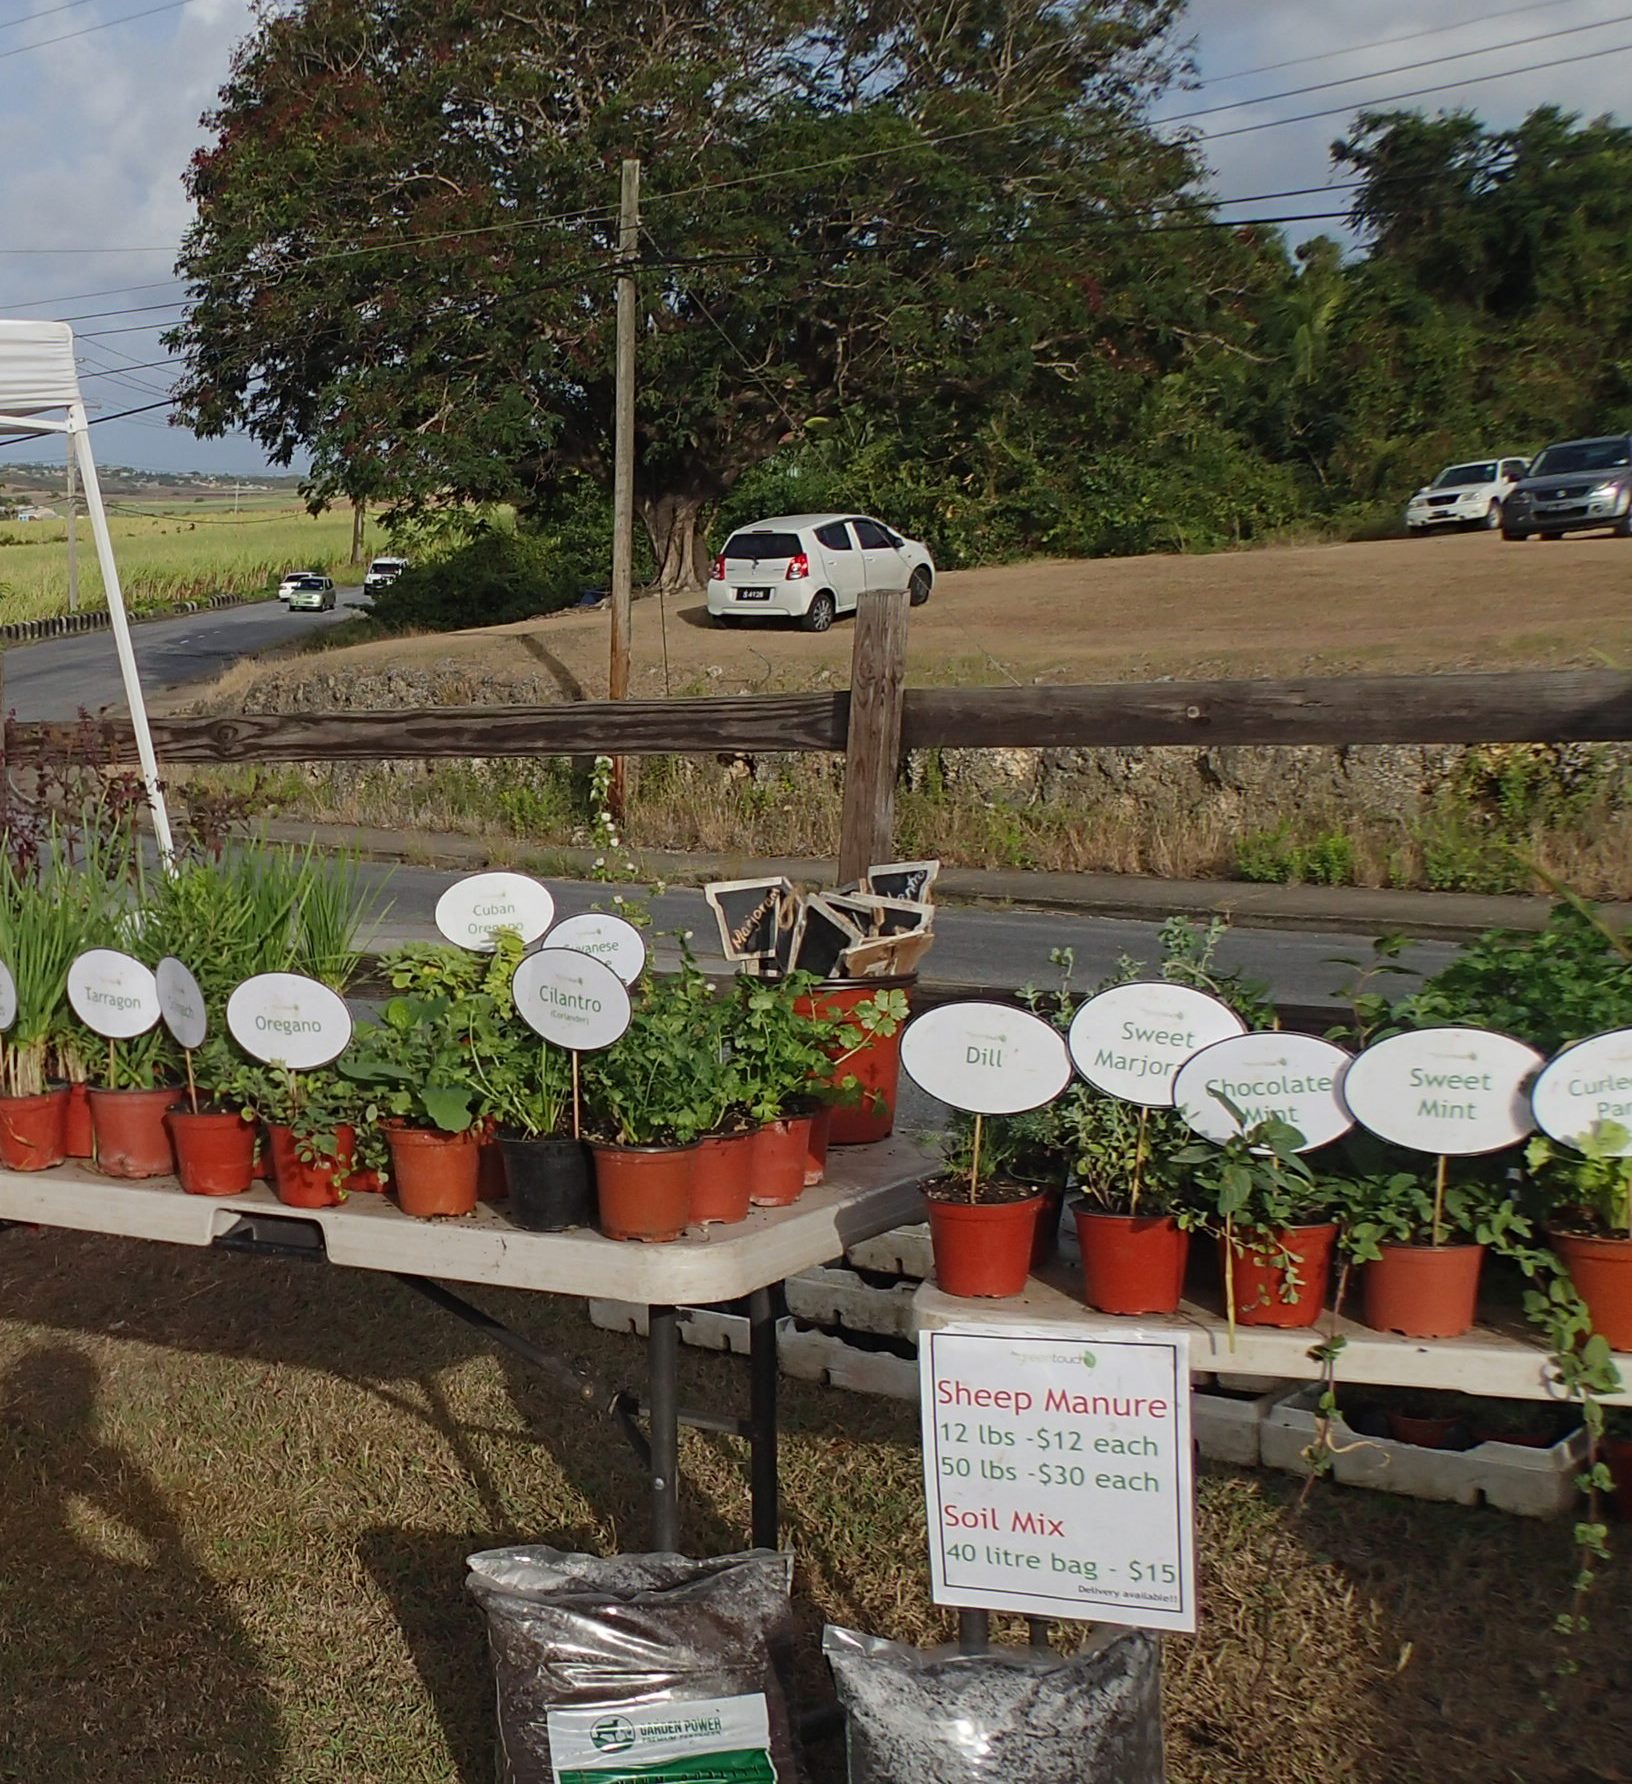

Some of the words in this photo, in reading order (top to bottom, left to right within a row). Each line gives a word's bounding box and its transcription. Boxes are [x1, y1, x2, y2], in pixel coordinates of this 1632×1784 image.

[473, 904, 515, 916] Cuban
[85, 986, 141, 1010] Tarragon
[539, 985, 601, 1012] Cilantro
[255, 1015, 322, 1036] Oregano
[1121, 1021, 1195, 1048] Sweet
[966, 1046, 1003, 1067] Dill
[1094, 1049, 1183, 1077] Marjor
[1205, 1075, 1332, 1097] Chocolate
[1409, 1068, 1492, 1091] Sweet
[1569, 1075, 1632, 1097] Curle
[1417, 1099, 1477, 1120] Mint
[937, 1380, 1033, 1415] Sheep
[1044, 1388, 1168, 1418] Manure
[940, 1423, 968, 1443] 12
[979, 1424, 1015, 1446] lbs
[1026, 1427, 1083, 1451] -$12
[1094, 1436, 1159, 1456] each
[941, 1457, 970, 1477] 50
[980, 1459, 1017, 1481] lbs
[1027, 1463, 1085, 1487] -$30
[1095, 1471, 1160, 1492] each
[944, 1505, 999, 1531] Soil
[1011, 1510, 1065, 1537] Mix
[946, 1544, 976, 1562] 40
[986, 1546, 1041, 1569] litre
[1051, 1553, 1098, 1580] bag
[1129, 1560, 1176, 1584] $15
[1078, 1585, 1119, 1598] Delivery
[684, 1717, 722, 1733] POWER
